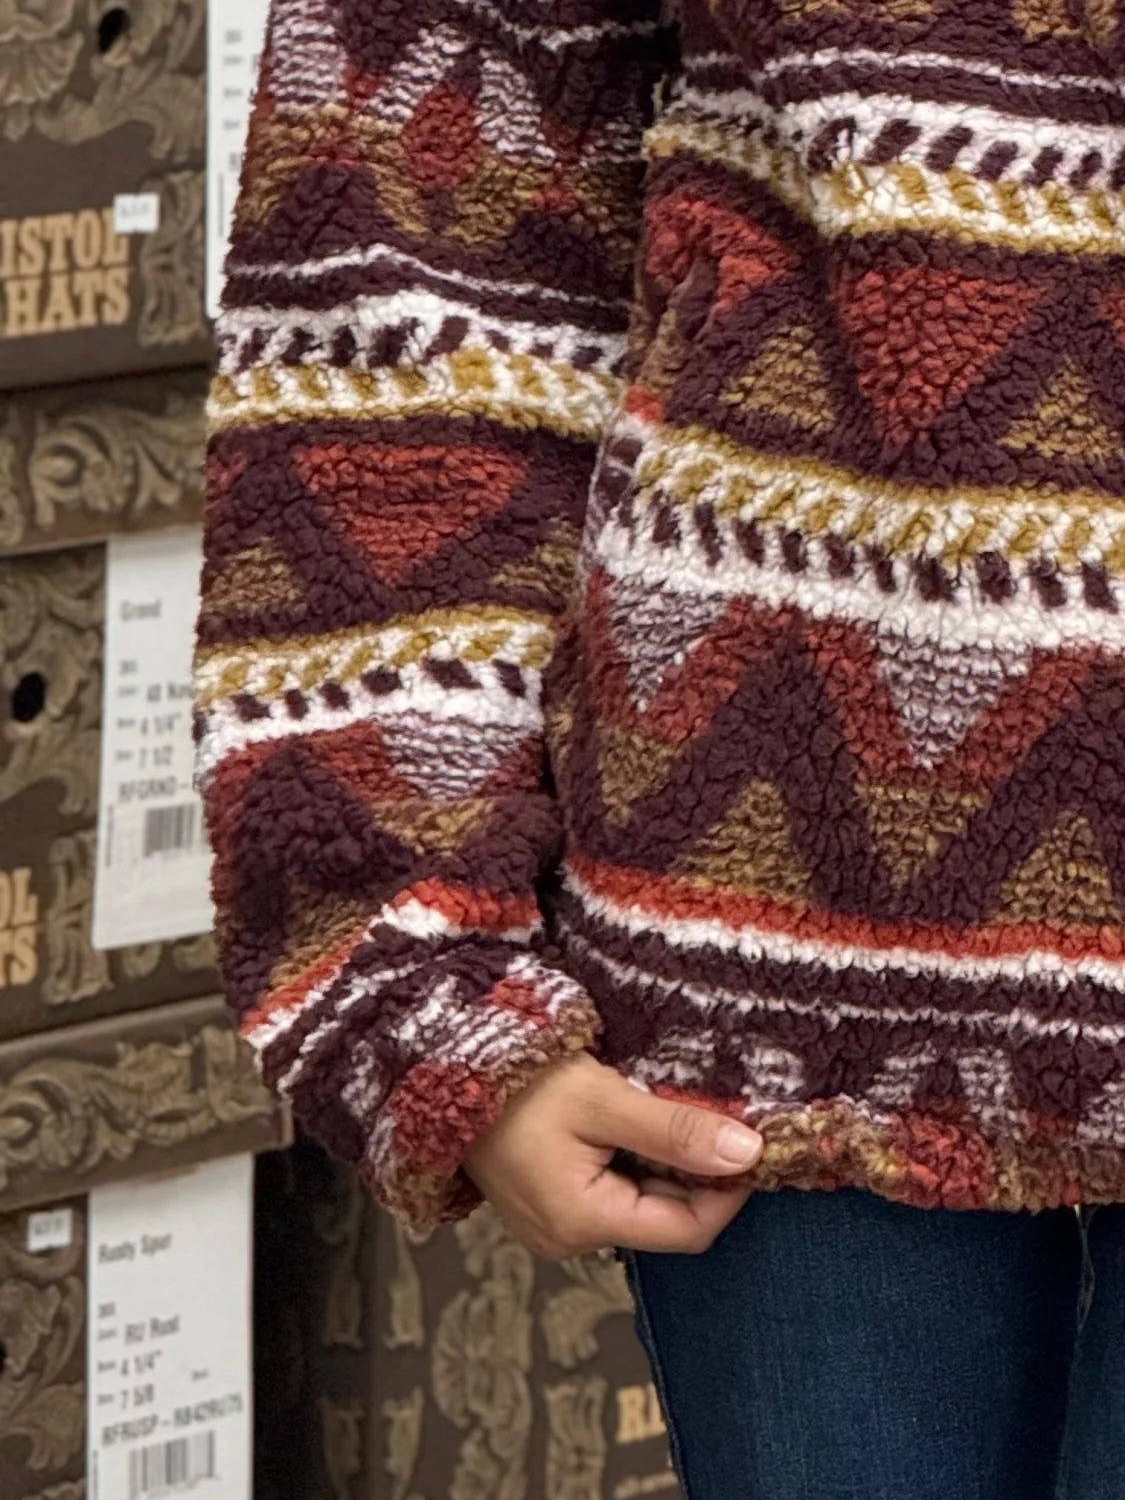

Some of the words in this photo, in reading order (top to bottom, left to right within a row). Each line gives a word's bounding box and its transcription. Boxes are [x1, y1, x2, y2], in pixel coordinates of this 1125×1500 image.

[4, 266, 130, 336] HATS
[98, 1241, 136, 1264] Rusty
[140, 1233, 173, 1258] Spur
